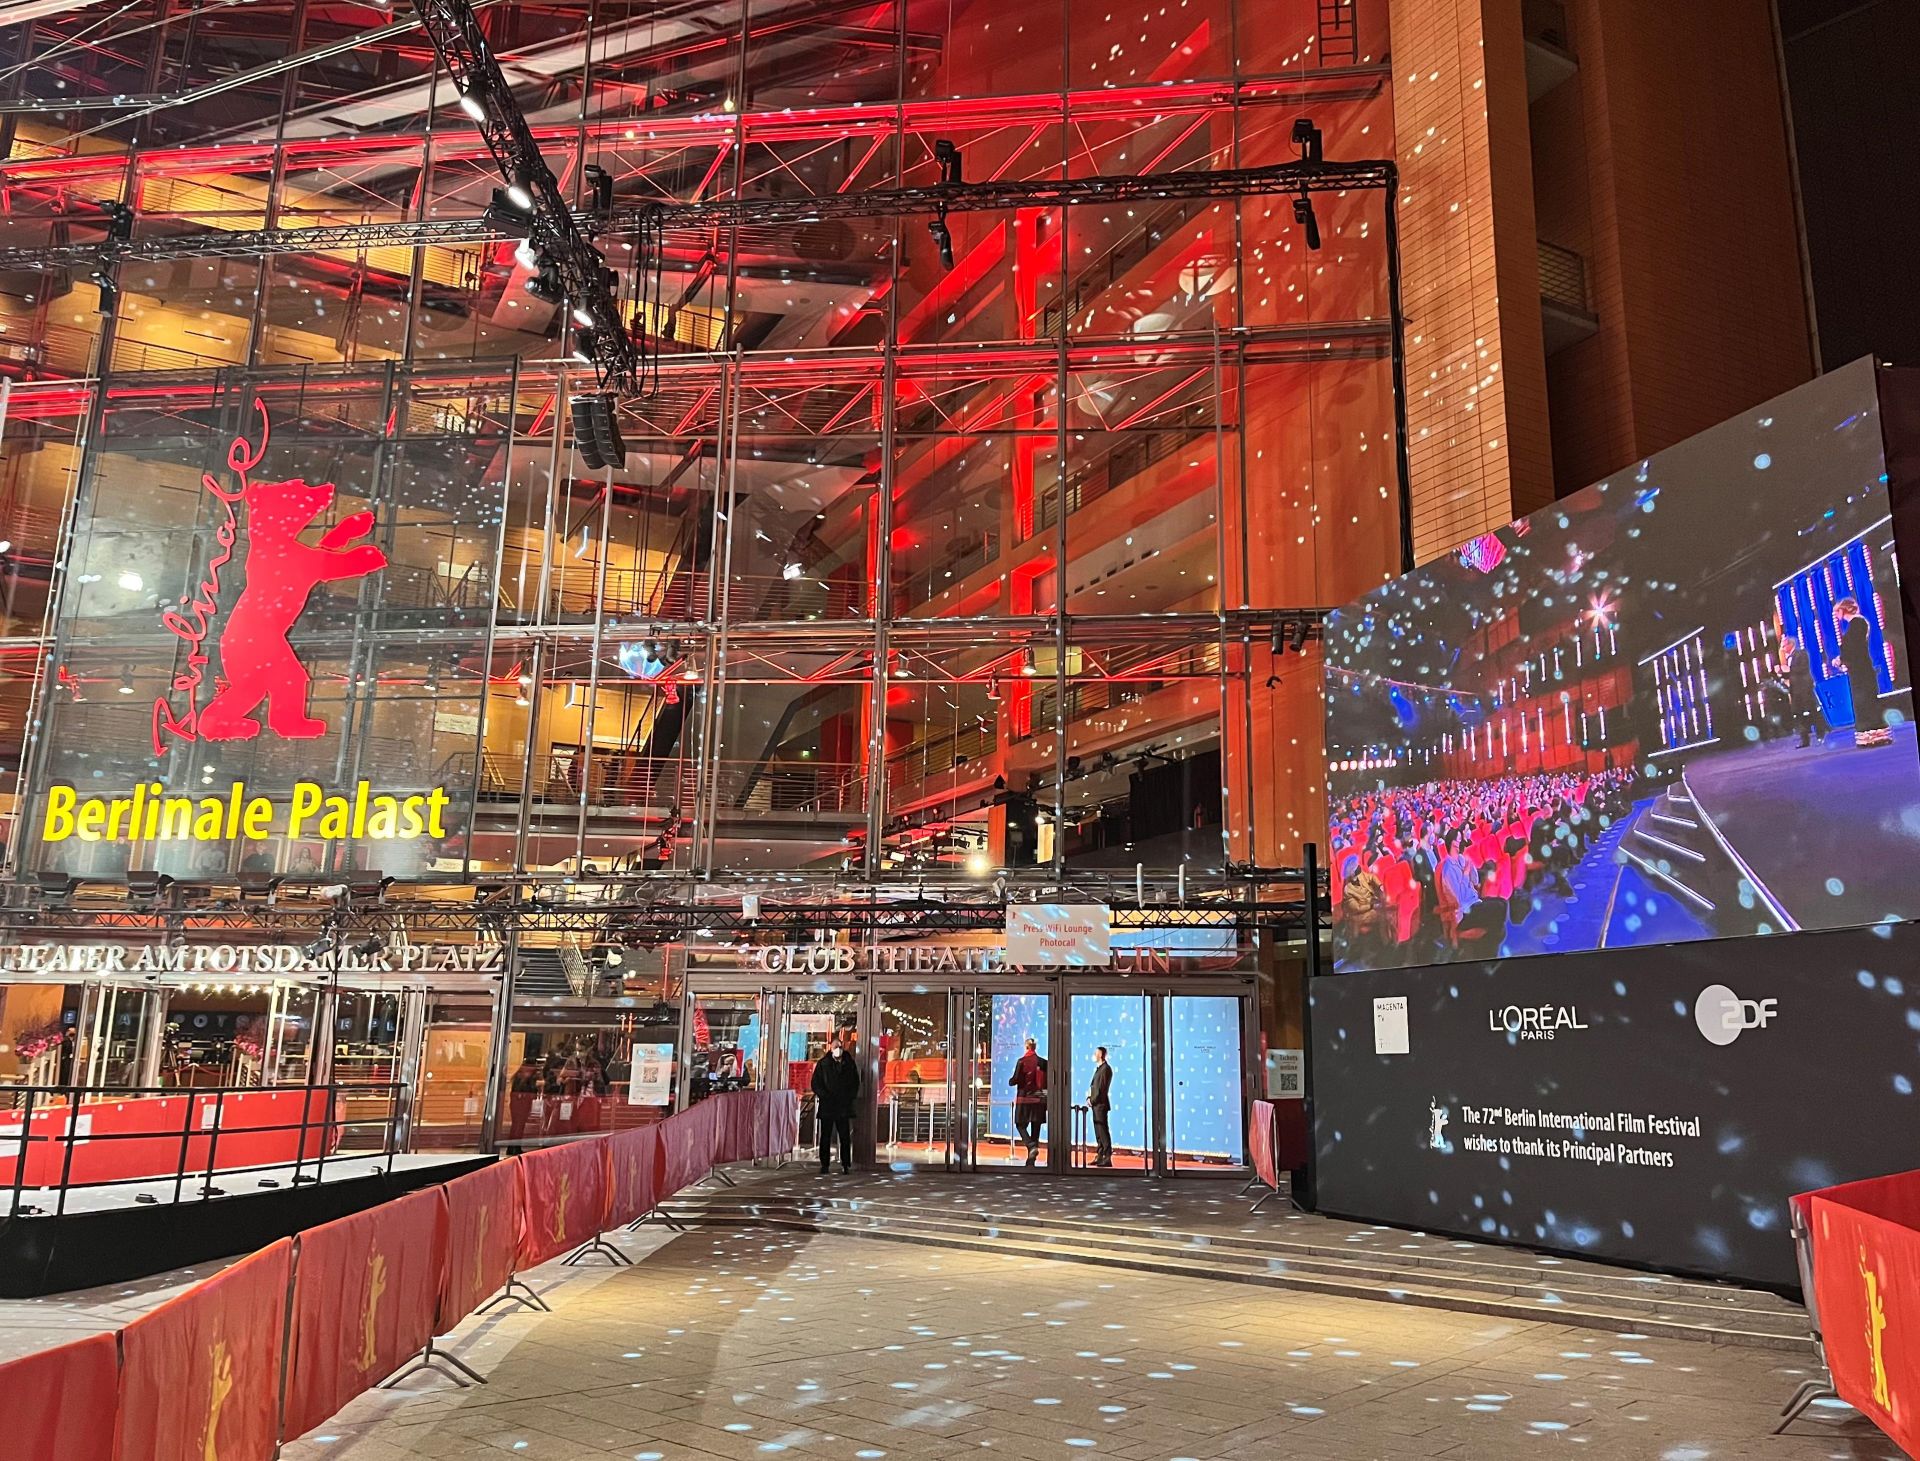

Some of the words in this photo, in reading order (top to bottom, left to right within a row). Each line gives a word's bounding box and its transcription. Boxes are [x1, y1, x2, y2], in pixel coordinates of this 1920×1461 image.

[152, 397, 270, 757] Berlinale
[42, 781, 272, 842] Berlinale
[288, 780, 450, 840] Palast
[1039, 938, 1076, 947] Photocall
[1064, 923, 1093, 935] Lounge
[130, 944, 190, 972] AM
[397, 945, 504, 973] PLATZ
[761, 944, 856, 974] CLUB
[1376, 1002, 1404, 1011] MAGENTA
[1489, 1003, 1589, 1033] L'ORÉAL
[1521, 1030, 1555, 1040] PARIS
[1461, 1105, 1481, 1124] The
[1482, 1106, 1503, 1125] 72nd
[1504, 1107, 1536, 1127] Berlin
[1538, 1109, 1616, 1132] International
[1617, 1112, 1646, 1134] Film
[1647, 1114, 1701, 1137] Festival
[1463, 1133, 1498, 1152] wishes
[1499, 1136, 1511, 1154] to
[1512, 1136, 1545, 1157] thank
[1546, 1138, 1561, 1158] its
[1562, 1139, 1616, 1166] Principal
[1617, 1143, 1674, 1168] Partners
